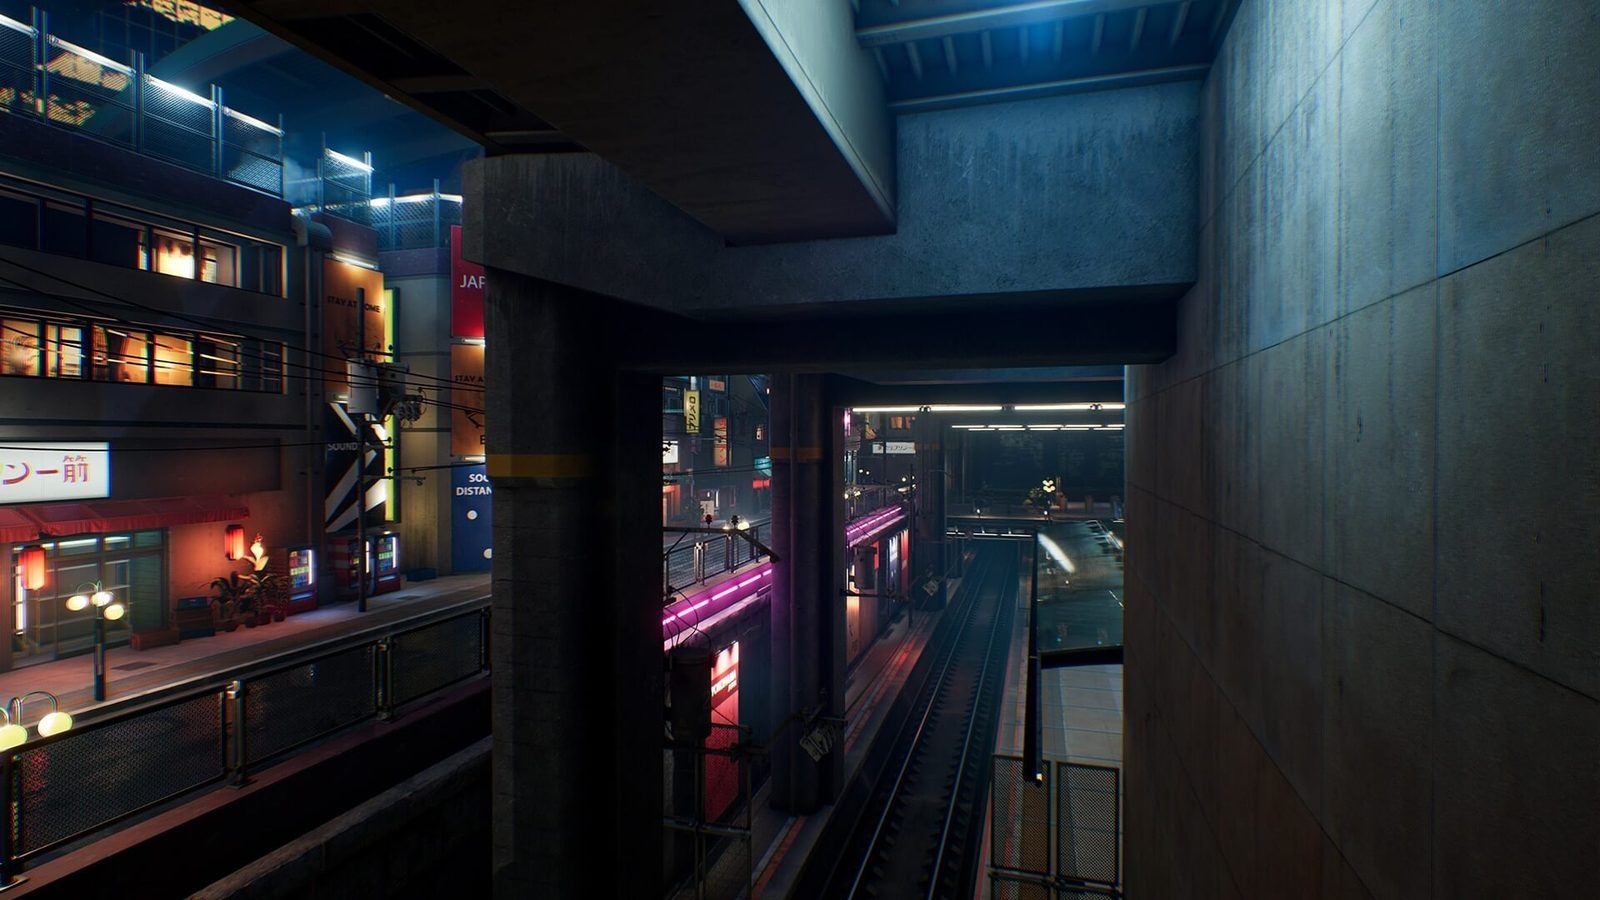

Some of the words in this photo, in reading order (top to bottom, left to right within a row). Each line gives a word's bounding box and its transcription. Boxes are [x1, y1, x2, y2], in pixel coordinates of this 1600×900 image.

[327, 295, 346, 306] STAY
[347, 299, 358, 308] AT
[454, 374, 476, 383] STAY
[327, 442, 358, 451] SOUND
